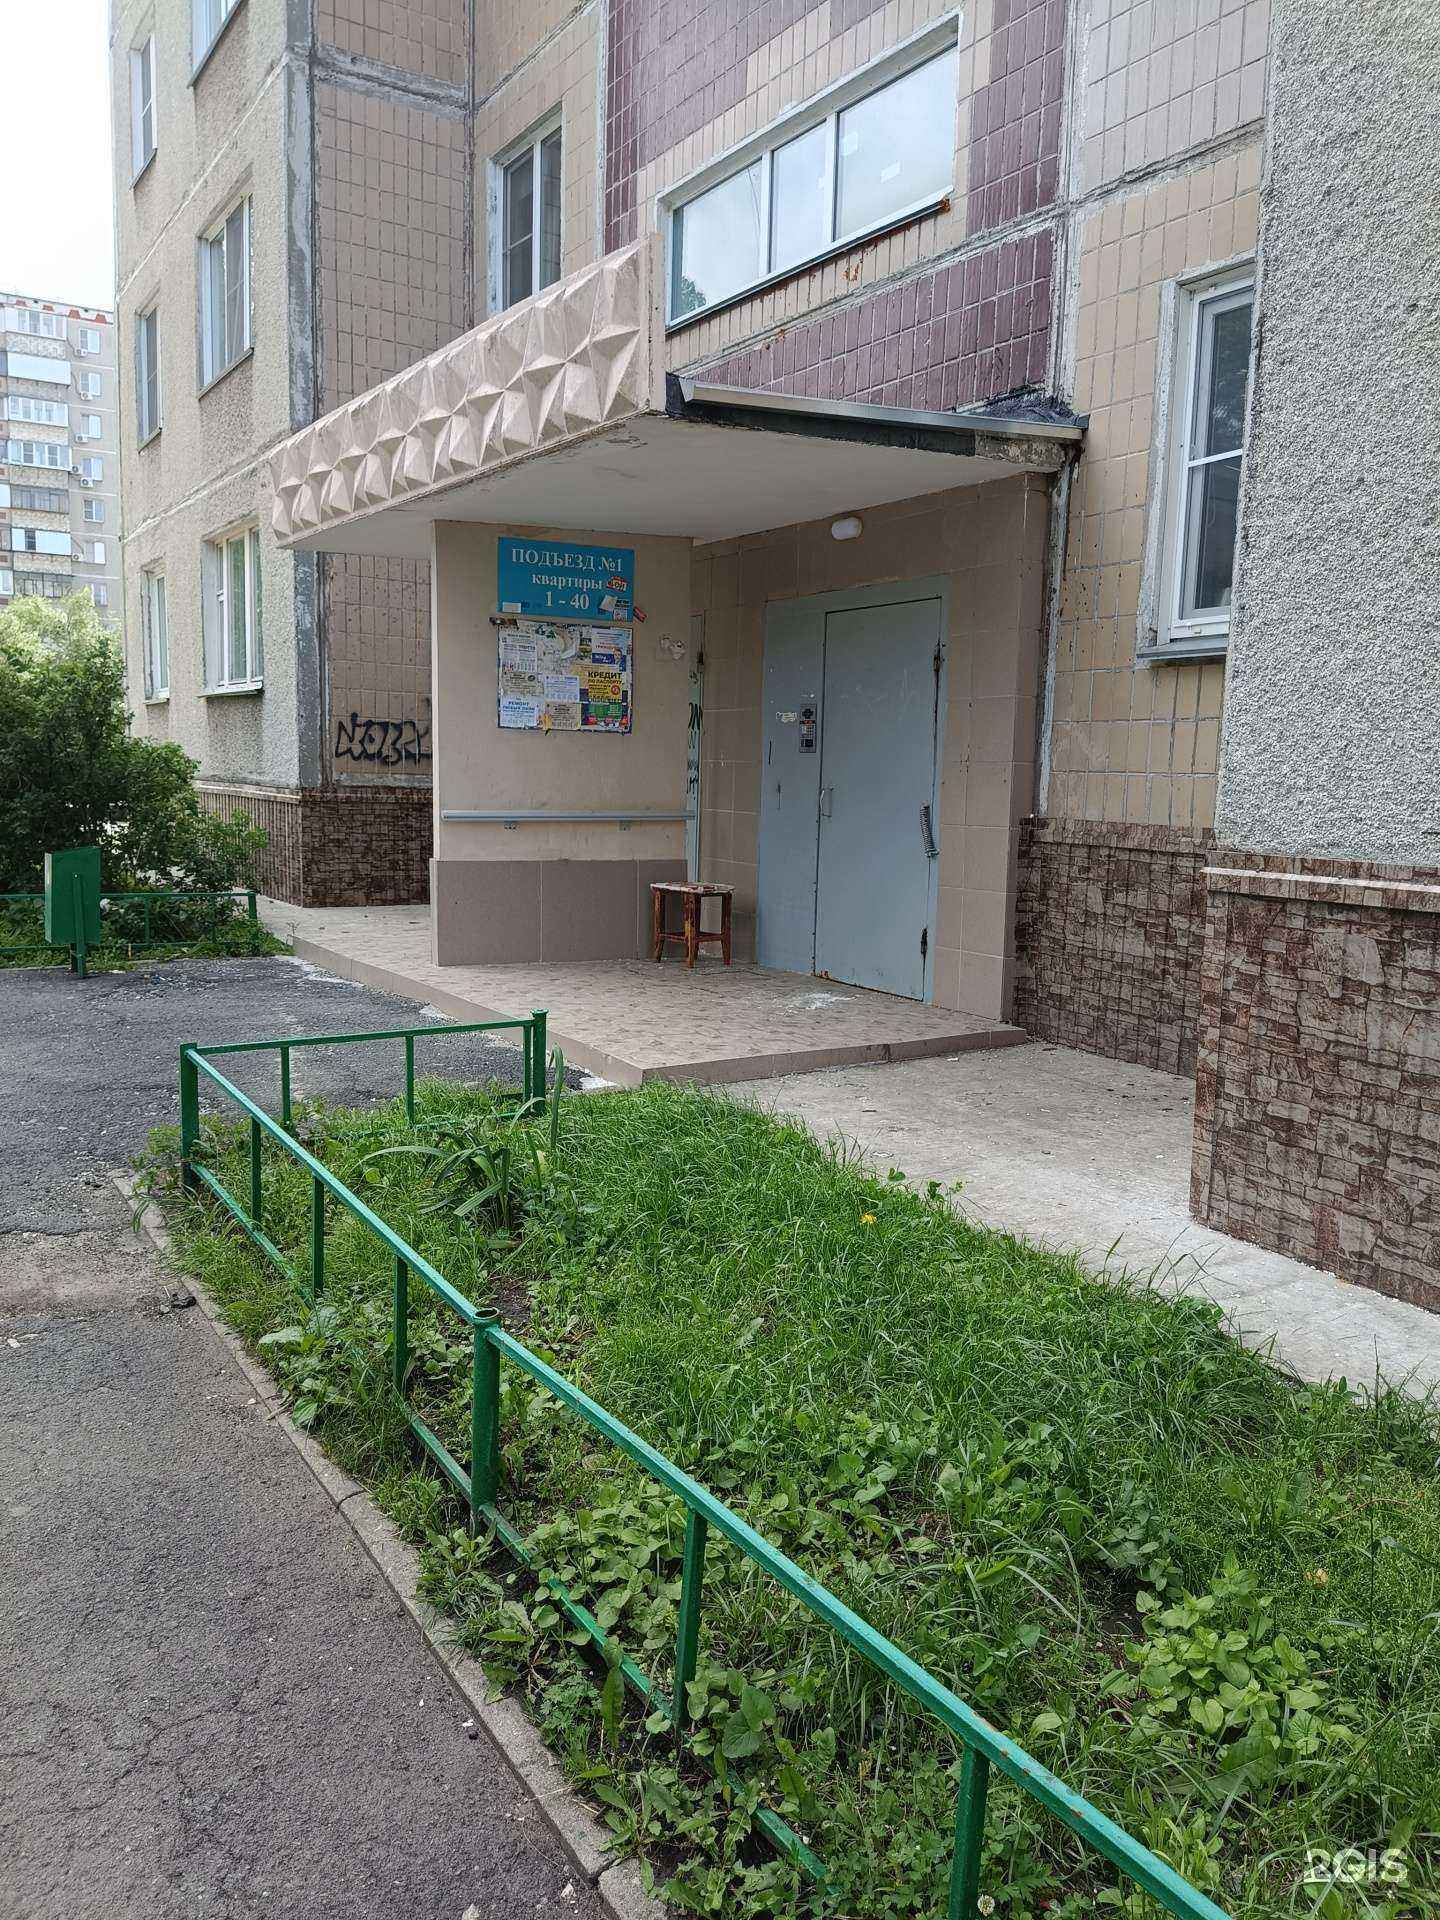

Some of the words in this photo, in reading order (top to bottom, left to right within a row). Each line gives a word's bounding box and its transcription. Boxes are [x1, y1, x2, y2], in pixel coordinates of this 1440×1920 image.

[512, 548, 595, 572] ПОДЪЕЗД
[598, 557, 623, 572] №1
[532, 573, 602, 591] квартиры
[570, 593, 590, 610] 40
[588, 671, 622, 680] КРЕДИТ
